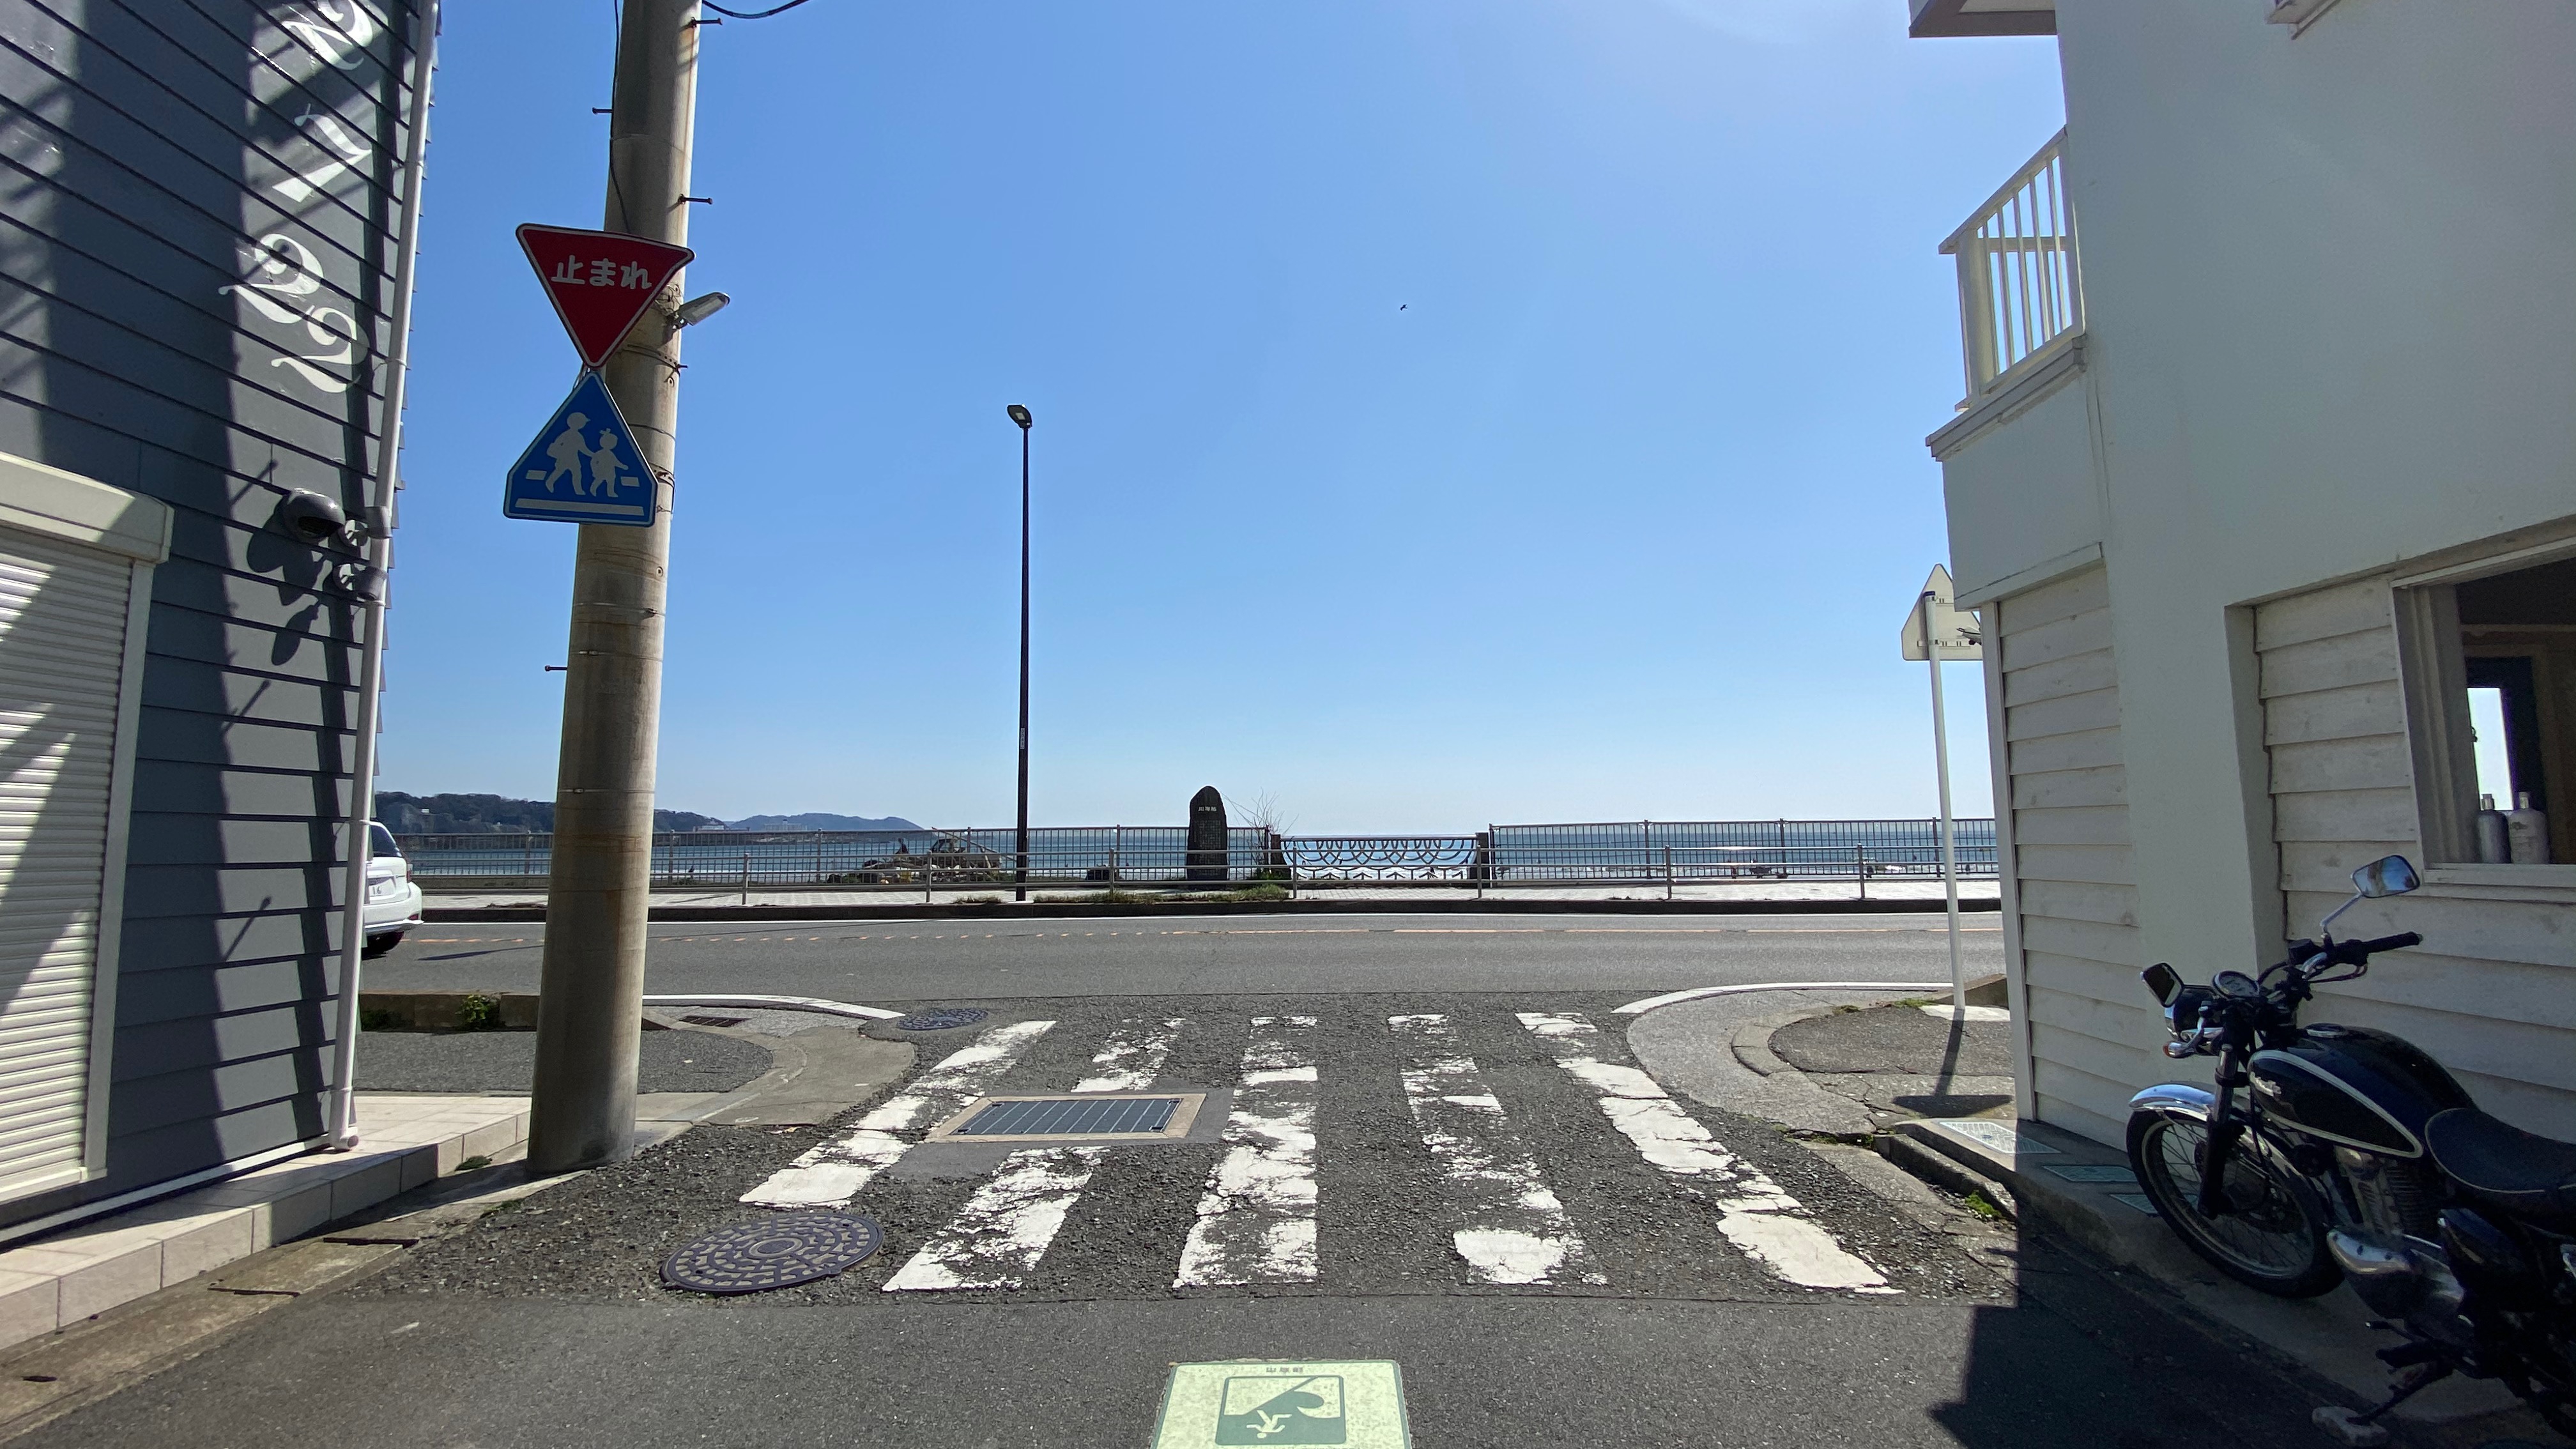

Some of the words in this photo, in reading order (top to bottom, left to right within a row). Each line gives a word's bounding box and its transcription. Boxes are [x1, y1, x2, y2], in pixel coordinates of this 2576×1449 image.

[282, 0, 372, 70] 2
[272, 103, 372, 203] 7
[551, 255, 652, 289] 止まれ
